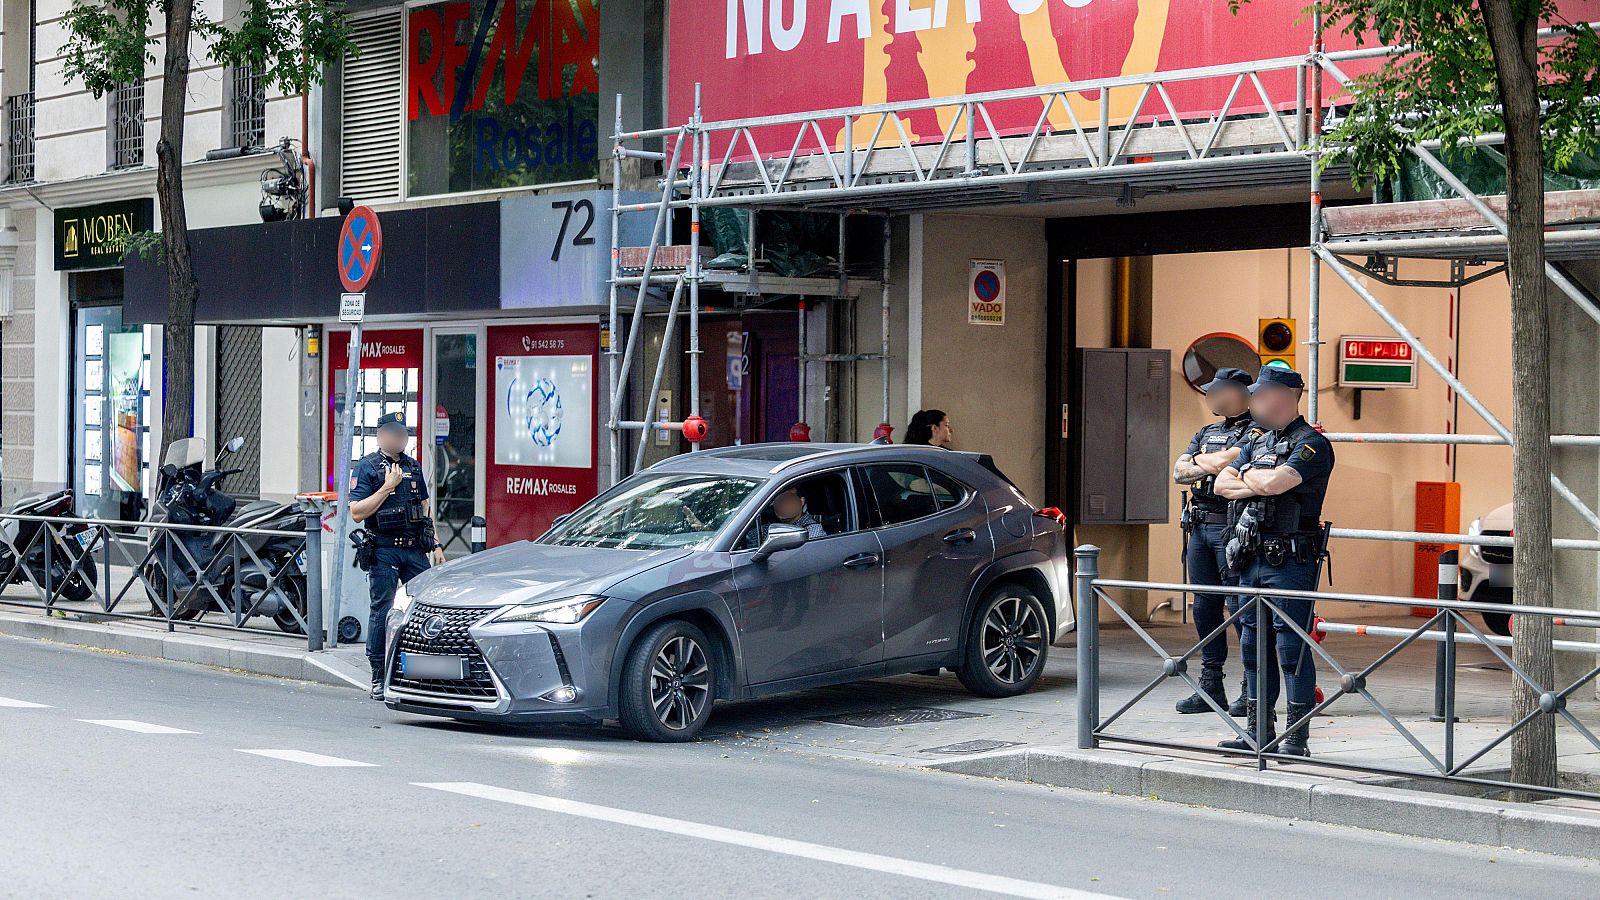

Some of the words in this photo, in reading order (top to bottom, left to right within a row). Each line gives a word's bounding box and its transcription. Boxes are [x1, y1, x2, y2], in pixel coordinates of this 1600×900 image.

[83, 213, 133, 244] MOBEN
[551, 199, 595, 261] 72
[91, 247, 104, 255] REAL
[972, 303, 1001, 312] VADO
[382, 345, 405, 354] ROSALES
[538, 340, 548, 349] 542
[1349, 342, 1408, 357] OCUPADO
[506, 477, 549, 496] RE/MAX
[548, 483, 577, 495] ROSALES
